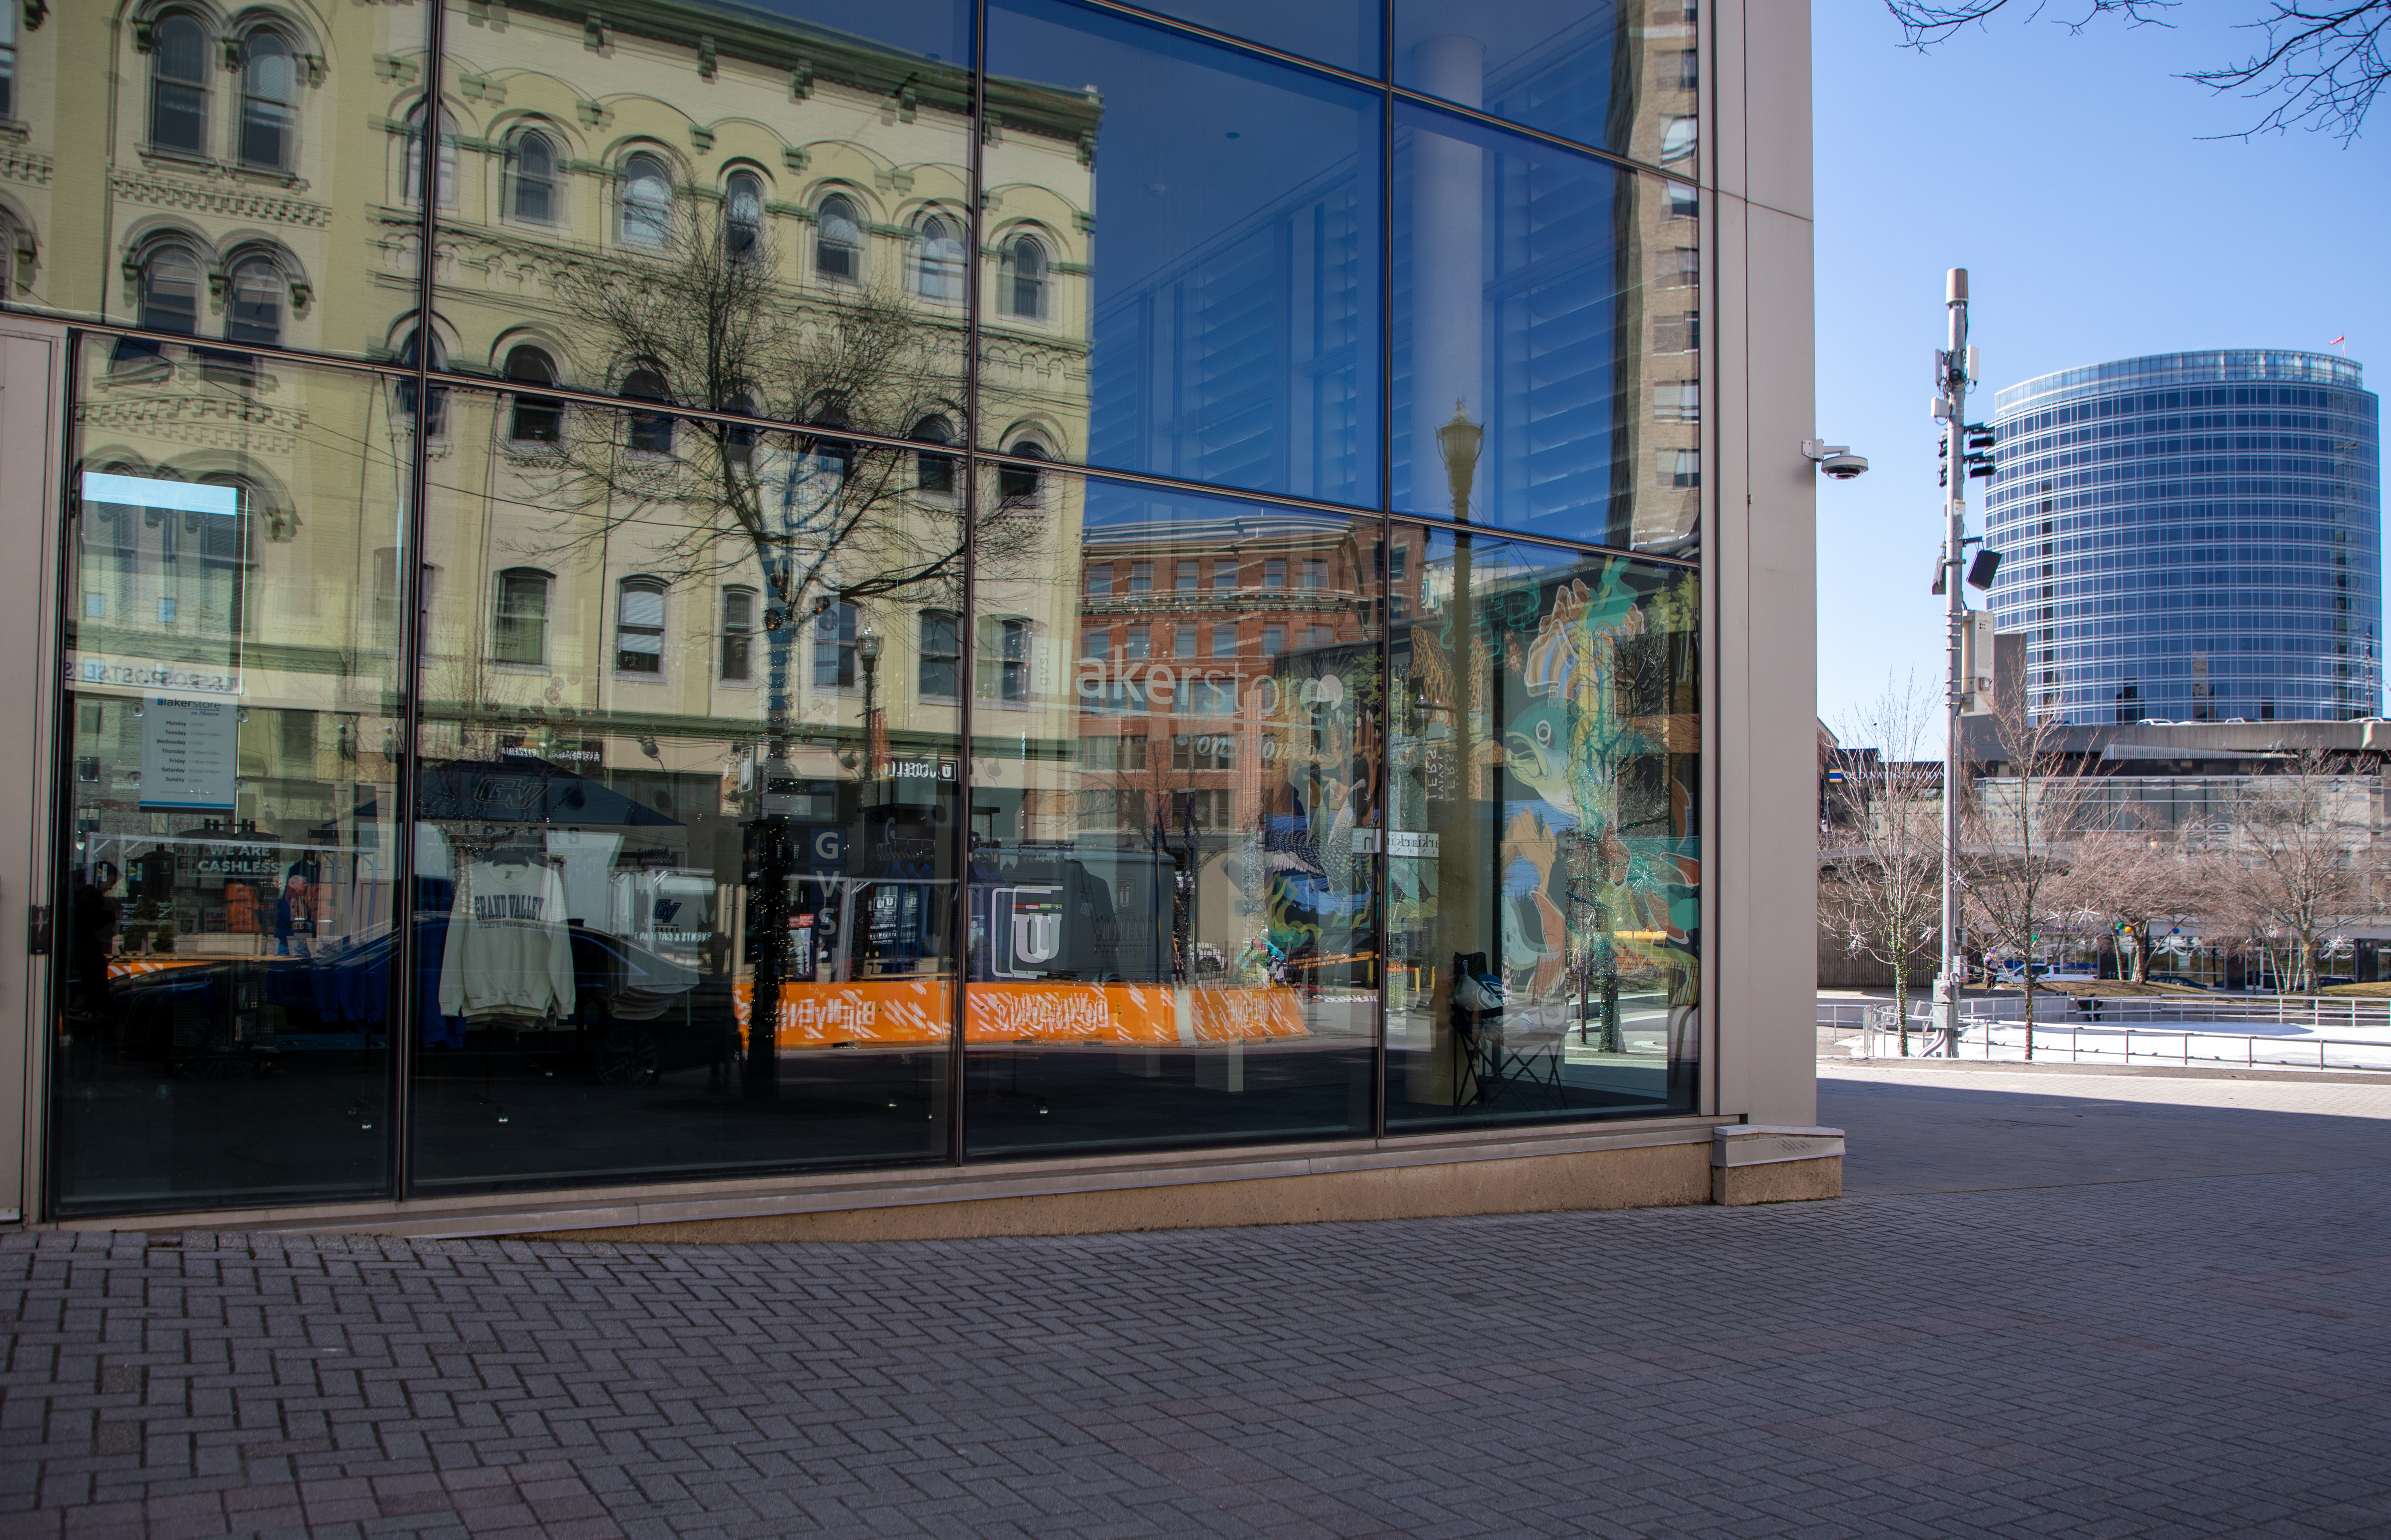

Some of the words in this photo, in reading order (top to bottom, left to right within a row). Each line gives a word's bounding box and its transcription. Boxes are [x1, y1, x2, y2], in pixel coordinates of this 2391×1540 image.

[1926, 771, 1945, 780] BAN
[209, 845, 235, 855] WE
[238, 845, 270, 856] ARE
[198, 860, 280, 873] CASHLESS
[475, 895, 506, 921] GRAND
[509, 895, 545, 921] VALLEY
[479, 921, 501, 929] STATE
[502, 920, 538, 929] UNIVERSITY
